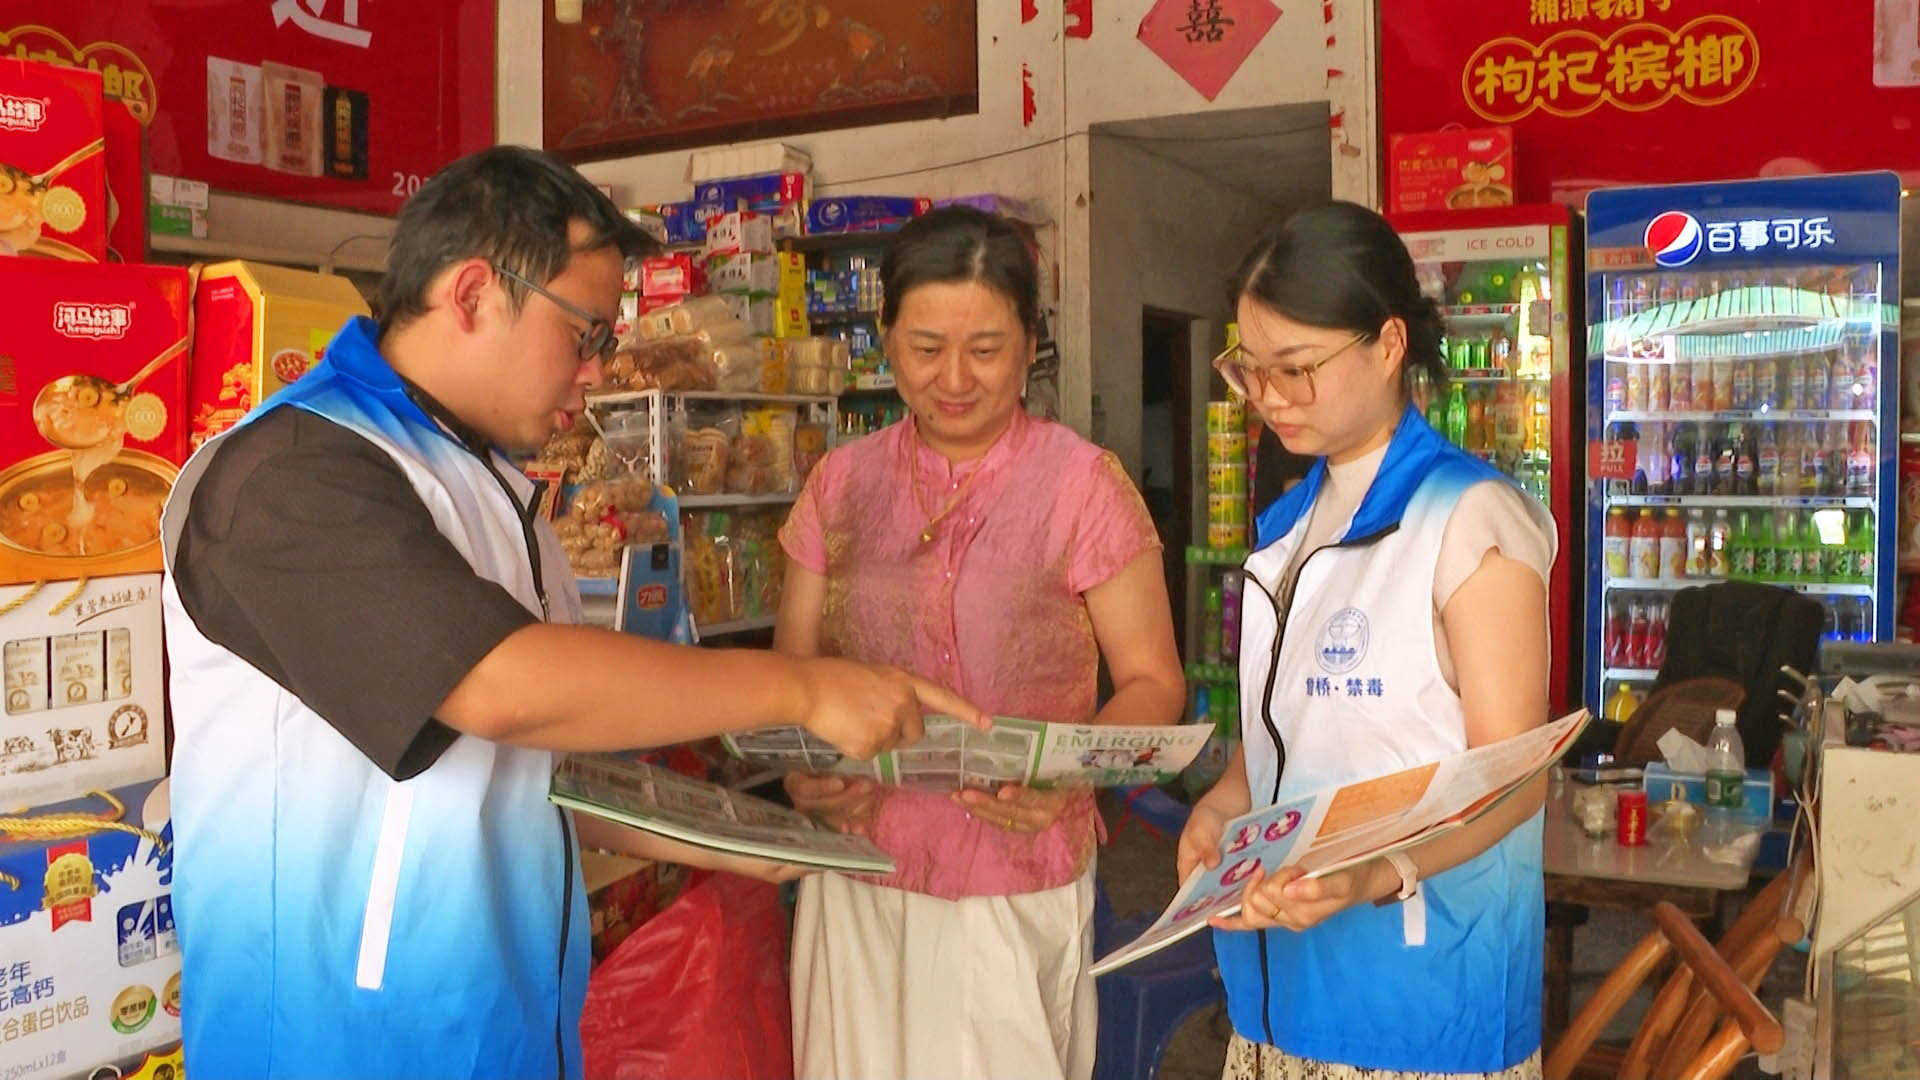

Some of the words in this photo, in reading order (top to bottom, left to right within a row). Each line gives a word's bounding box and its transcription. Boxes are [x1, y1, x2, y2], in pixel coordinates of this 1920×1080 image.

[1474, 35, 1745, 105] 枸杞槟榔
[1466, 239, 1488, 250] ICE
[1495, 236, 1535, 249] COLD
[1705, 216, 1836, 253] 百事可乐
[57, 305, 127, 328] 河马故事
[1056, 734, 1195, 748] EMERGING
[0, 995, 89, 1044] 合蛋白饮品
